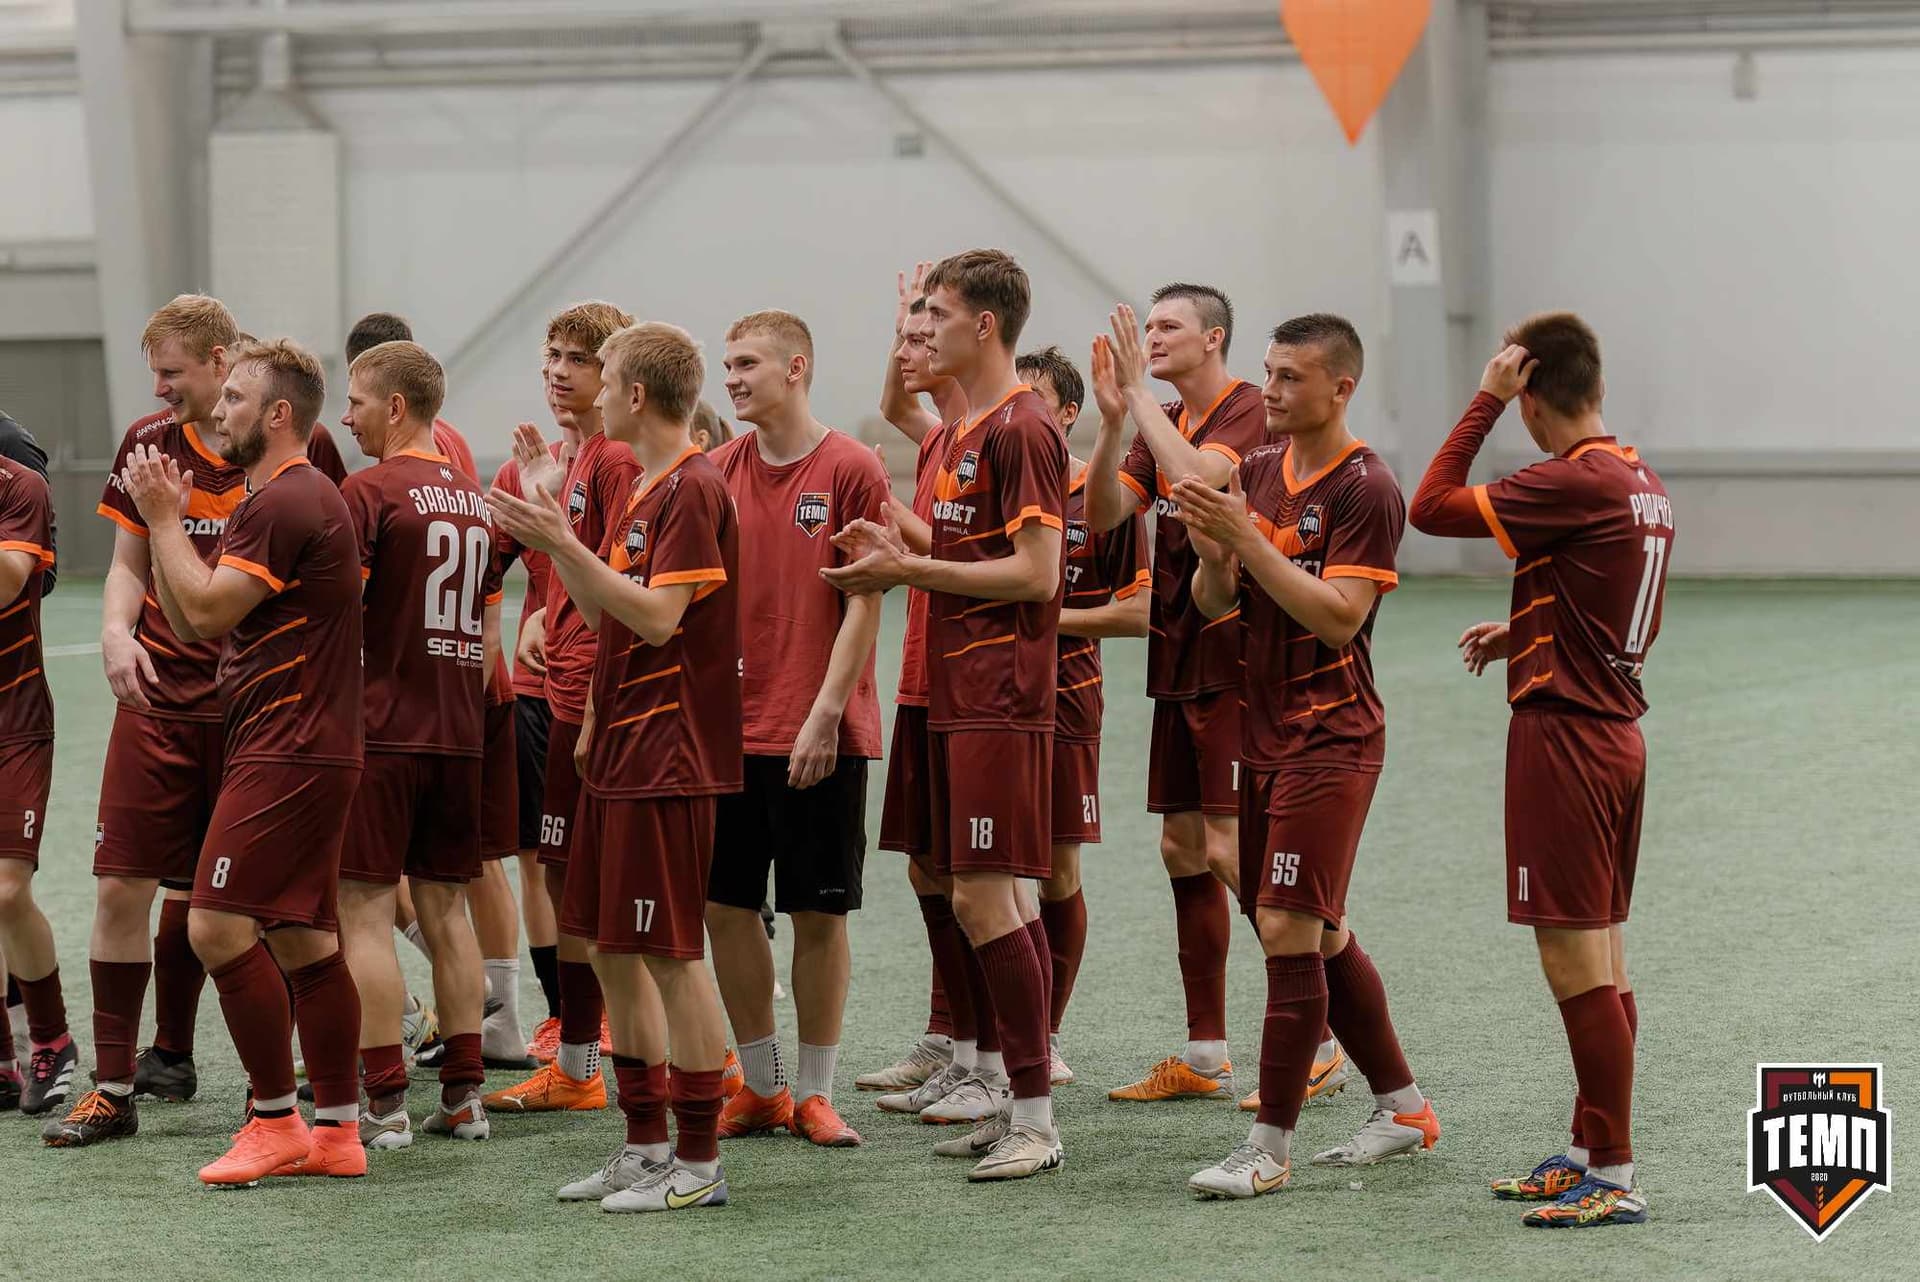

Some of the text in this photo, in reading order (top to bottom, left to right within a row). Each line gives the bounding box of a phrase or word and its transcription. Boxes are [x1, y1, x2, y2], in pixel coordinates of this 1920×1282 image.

[800, 504, 827, 521] ТЕМП
[1066, 528, 1086, 545] ЕМП
[424, 520, 490, 636] 20
[23, 809, 36, 840] 2
[1082, 794, 1098, 824] 21
[540, 814, 566, 847] 66
[969, 817, 994, 850] 18
[211, 856, 232, 889] 8
[1271, 852, 1301, 887] 55
[1518, 865, 1529, 902] 11
[633, 898, 656, 934] 17
